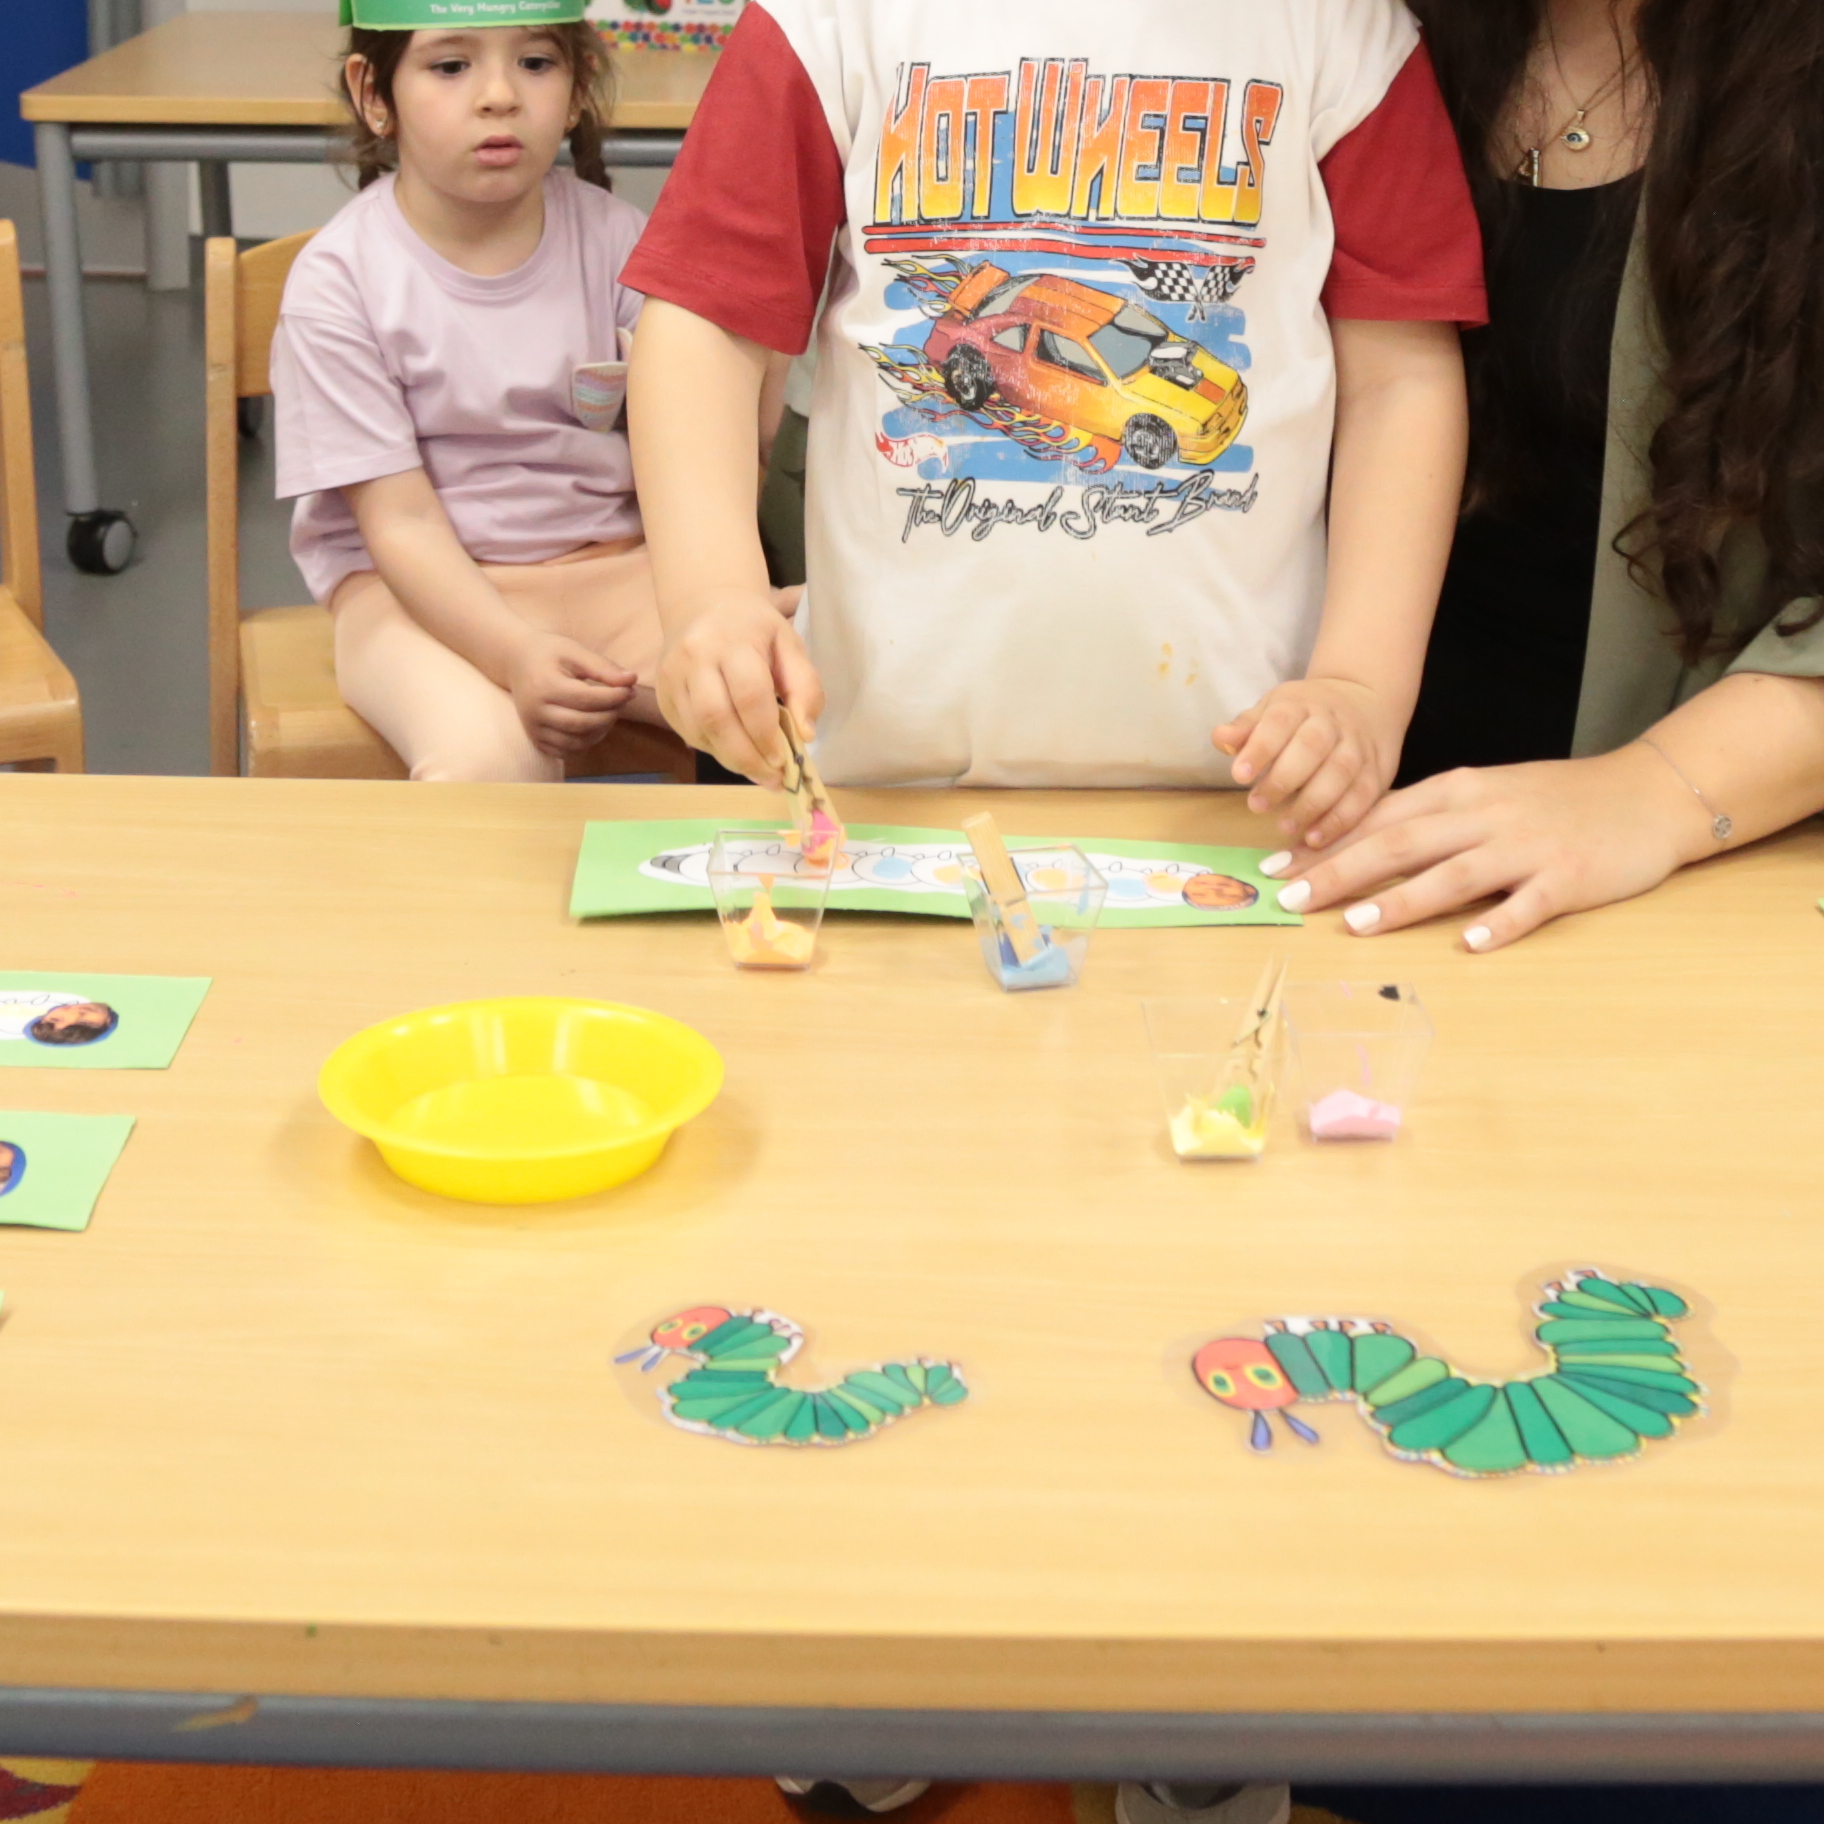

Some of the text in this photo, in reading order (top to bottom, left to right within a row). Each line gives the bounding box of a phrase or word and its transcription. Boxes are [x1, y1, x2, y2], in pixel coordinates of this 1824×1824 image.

[430, 3, 448, 14] The
[450, 3, 475, 16] Very
[477, 2, 516, 15] Hungry
[873, 56, 1285, 227] HOT WHEELS
[896, 482, 944, 544] The
[940, 476, 1064, 541] Original
[1146, 468, 1260, 537] Brand
